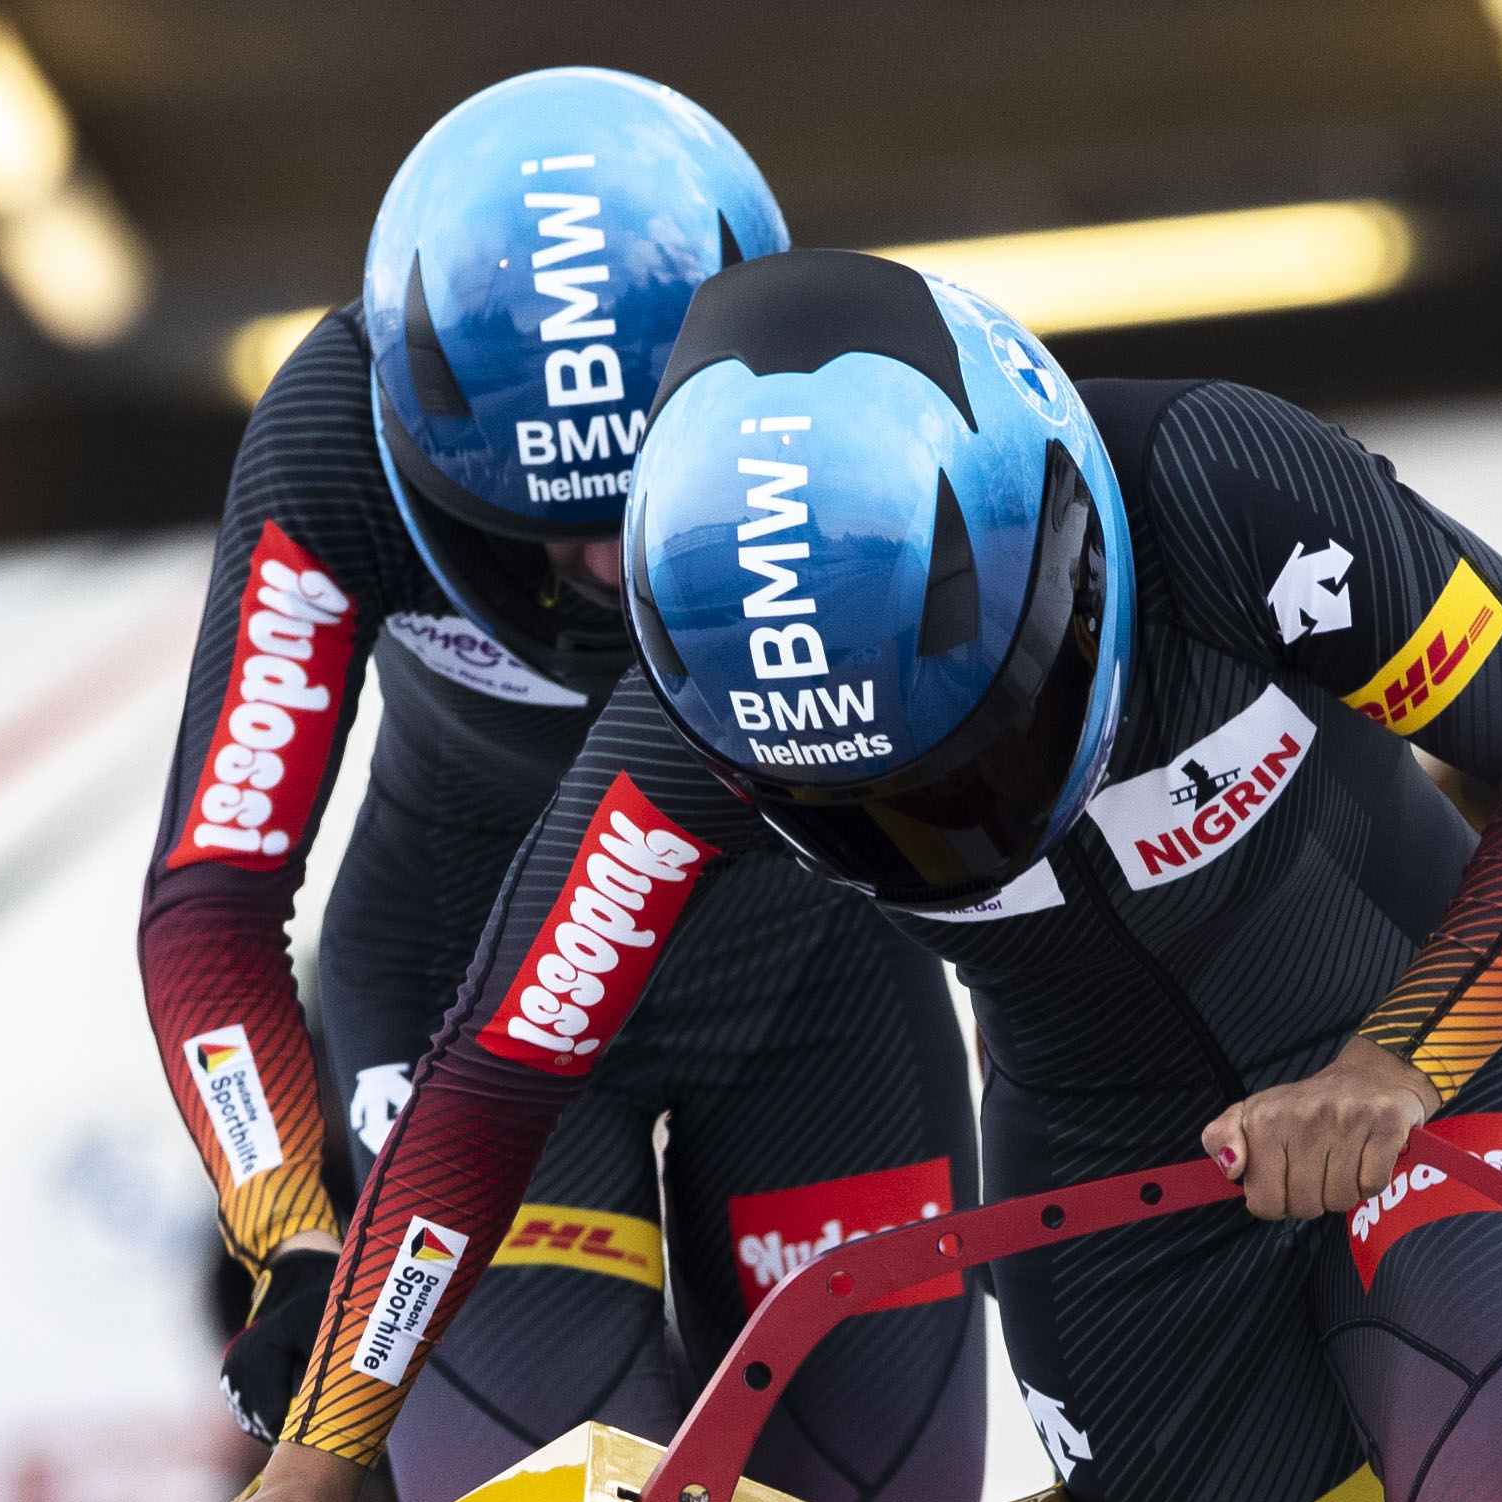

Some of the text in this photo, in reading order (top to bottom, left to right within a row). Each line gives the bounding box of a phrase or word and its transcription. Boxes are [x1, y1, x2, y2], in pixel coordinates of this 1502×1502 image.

[519, 153, 625, 408] BMW i
[516, 410, 648, 466] BMW
[526, 469, 634, 503] helme
[735, 415, 828, 681] BMW i
[193, 558, 350, 858] Nudossi
[729, 680, 876, 733] BMW
[748, 730, 894, 768] helmets
[1133, 731, 1302, 877] NIGRIN
[507, 809, 702, 1057] Nudossi
[210, 1075, 258, 1175] Sporthilfe
[507, 1219, 625, 1260] HL
[363, 1266, 426, 1370] Sporhilfe
